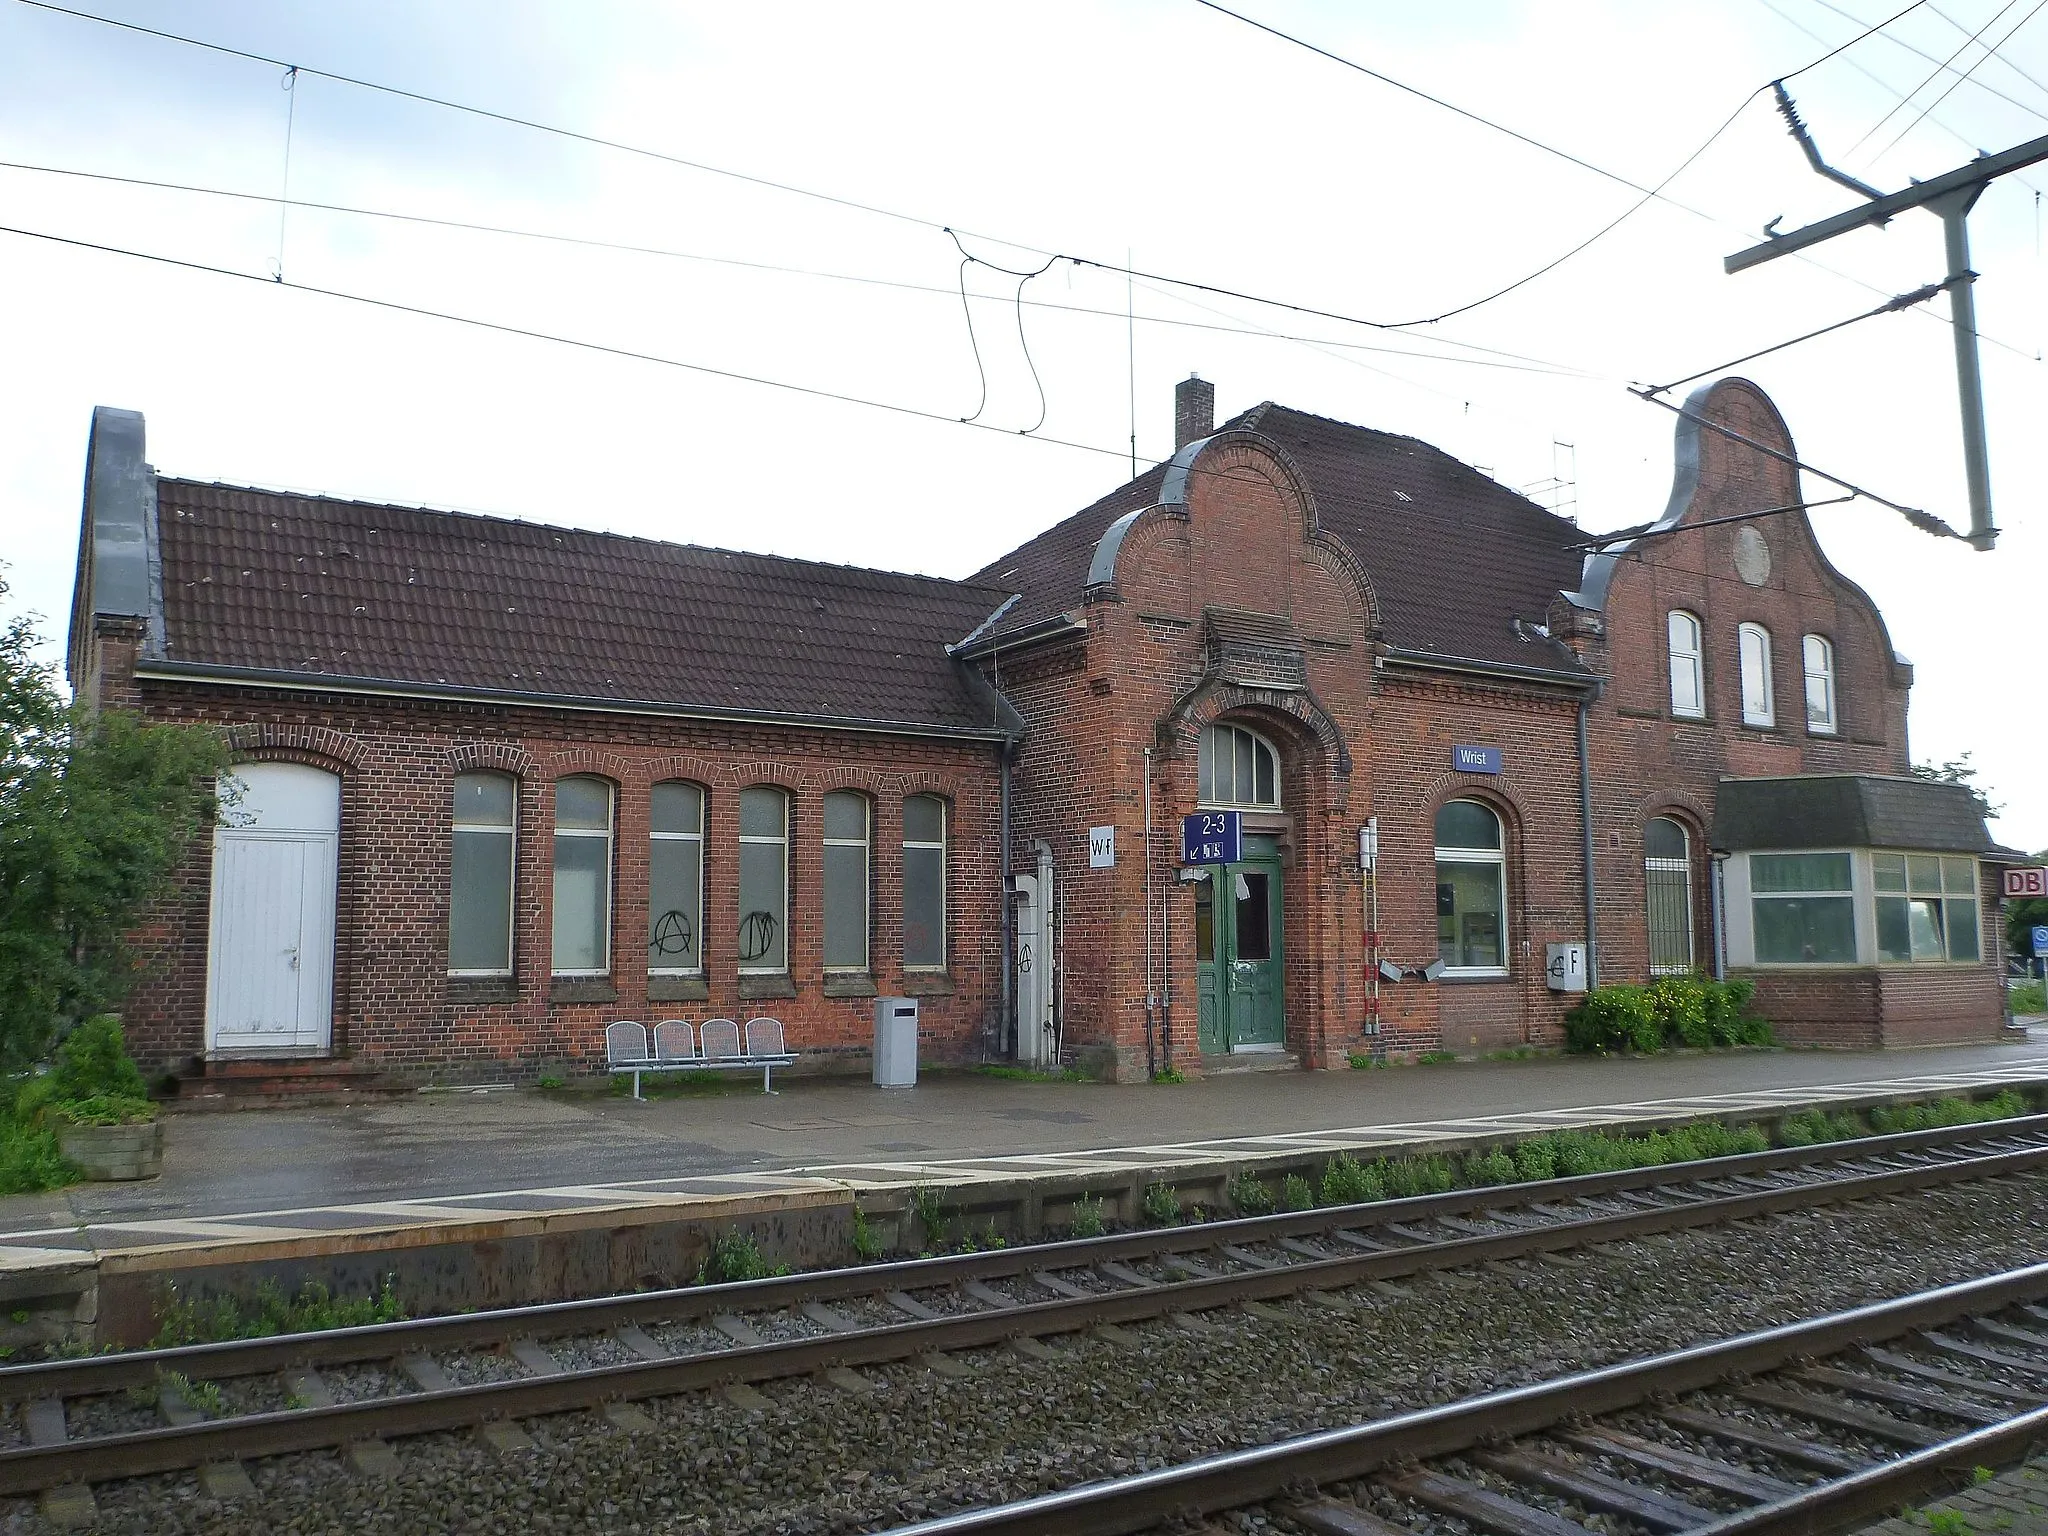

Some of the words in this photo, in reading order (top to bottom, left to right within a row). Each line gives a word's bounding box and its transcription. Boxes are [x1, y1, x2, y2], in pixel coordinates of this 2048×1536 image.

[1460, 749, 1486, 765] Wrist
[1202, 813, 1225, 835] 2-3
[2007, 872, 2040, 892] DB
[1571, 949, 1578, 973] F
